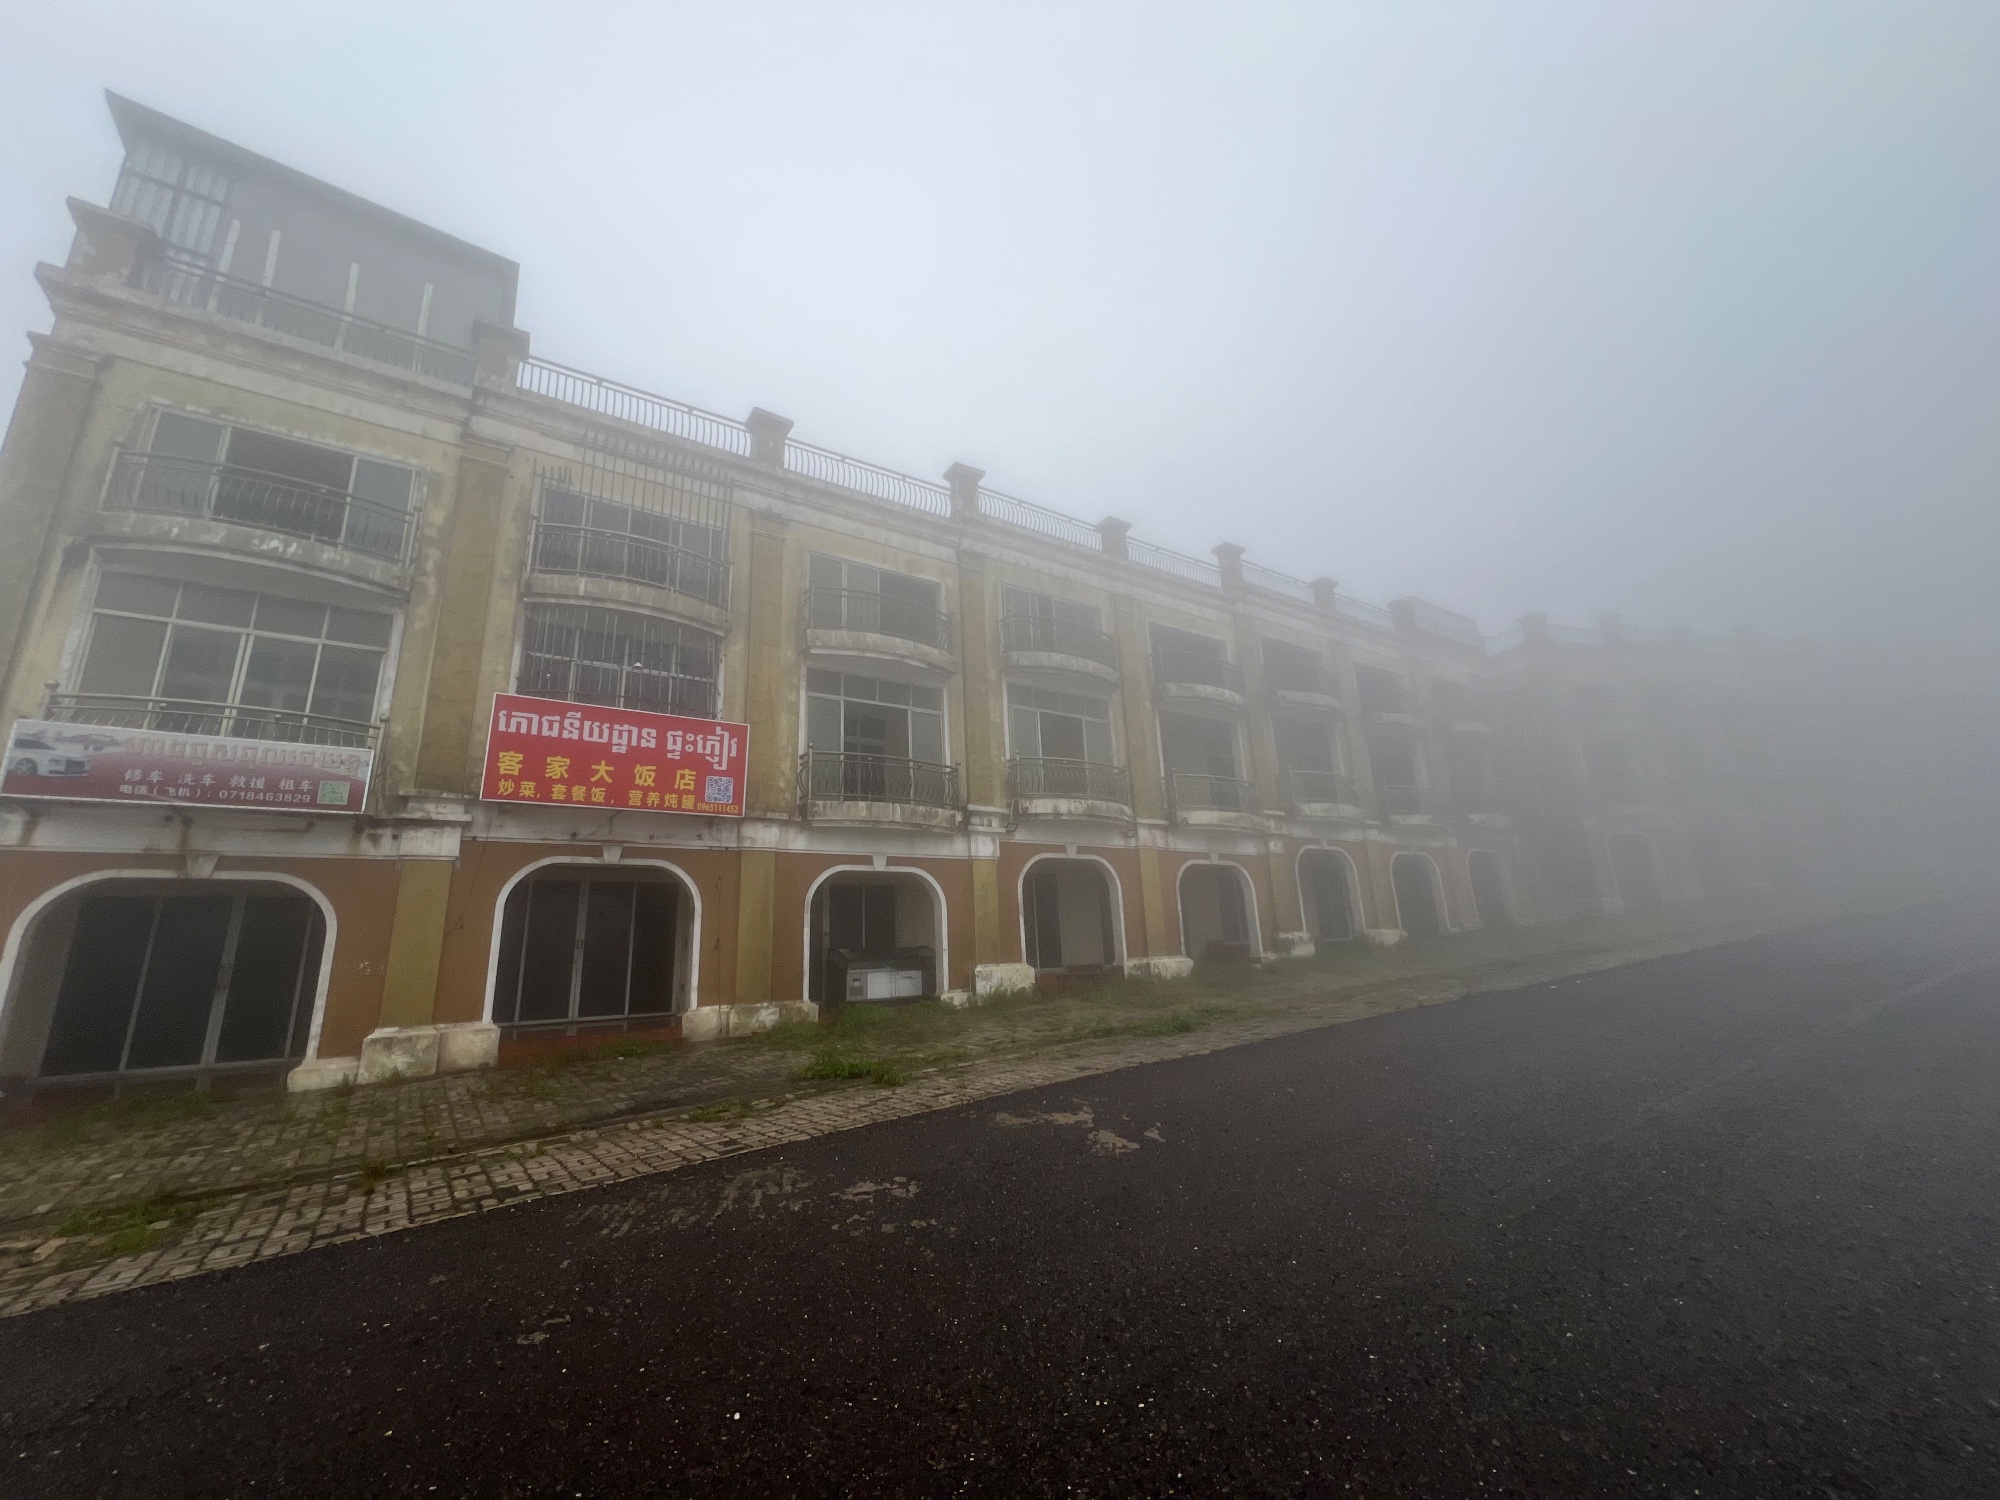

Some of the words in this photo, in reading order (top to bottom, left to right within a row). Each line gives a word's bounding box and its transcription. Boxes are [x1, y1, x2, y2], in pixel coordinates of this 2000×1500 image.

[124, 768, 164, 784] 修车
[177, 772, 216, 787] 洗车
[278, 778, 313, 793] 租车
[497, 751, 697, 791] 客家大饭店
[219, 790, 311, 803] 0718463829
